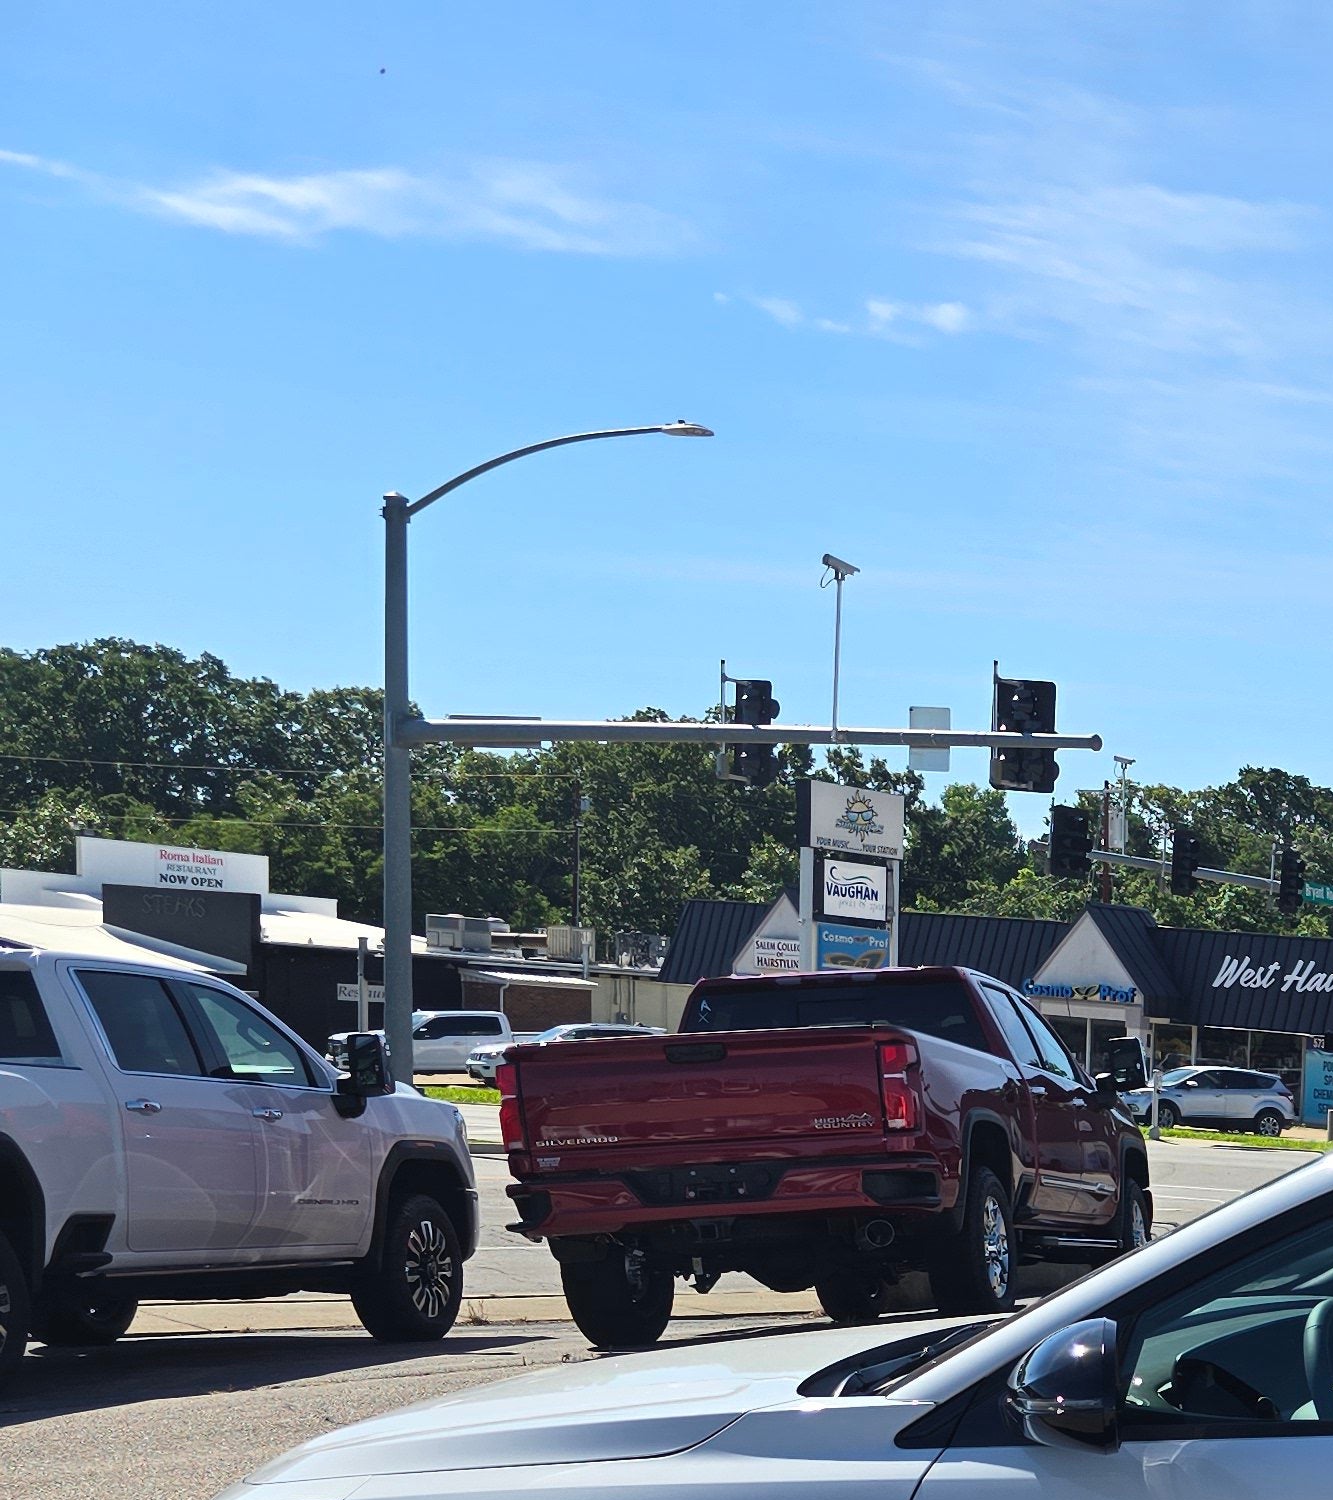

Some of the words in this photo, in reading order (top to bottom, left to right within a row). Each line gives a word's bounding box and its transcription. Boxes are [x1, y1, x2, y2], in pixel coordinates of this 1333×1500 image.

[159, 849, 190, 863] Roma
[192, 852, 223, 866] Italian
[166, 863, 217, 876] RESTAURANT
[159, 873, 189, 885] NOW
[191, 876, 223, 888] OPEN
[826, 882, 879, 901] VAUGHAN
[142, 894, 206, 918] STEAKS
[755, 941, 776, 951] SALEM
[822, 931, 853, 944] Cosmo
[868, 936, 889, 948] Prof
[756, 956, 799, 969] HAIRSTYLIN
[1211, 955, 1281, 989] West
[1023, 978, 1073, 998] Cosmo
[1099, 984, 1137, 1003] Prof
[814, 1121, 873, 1129] COUNTRY
[535, 1136, 619, 1147] SILVERADO
